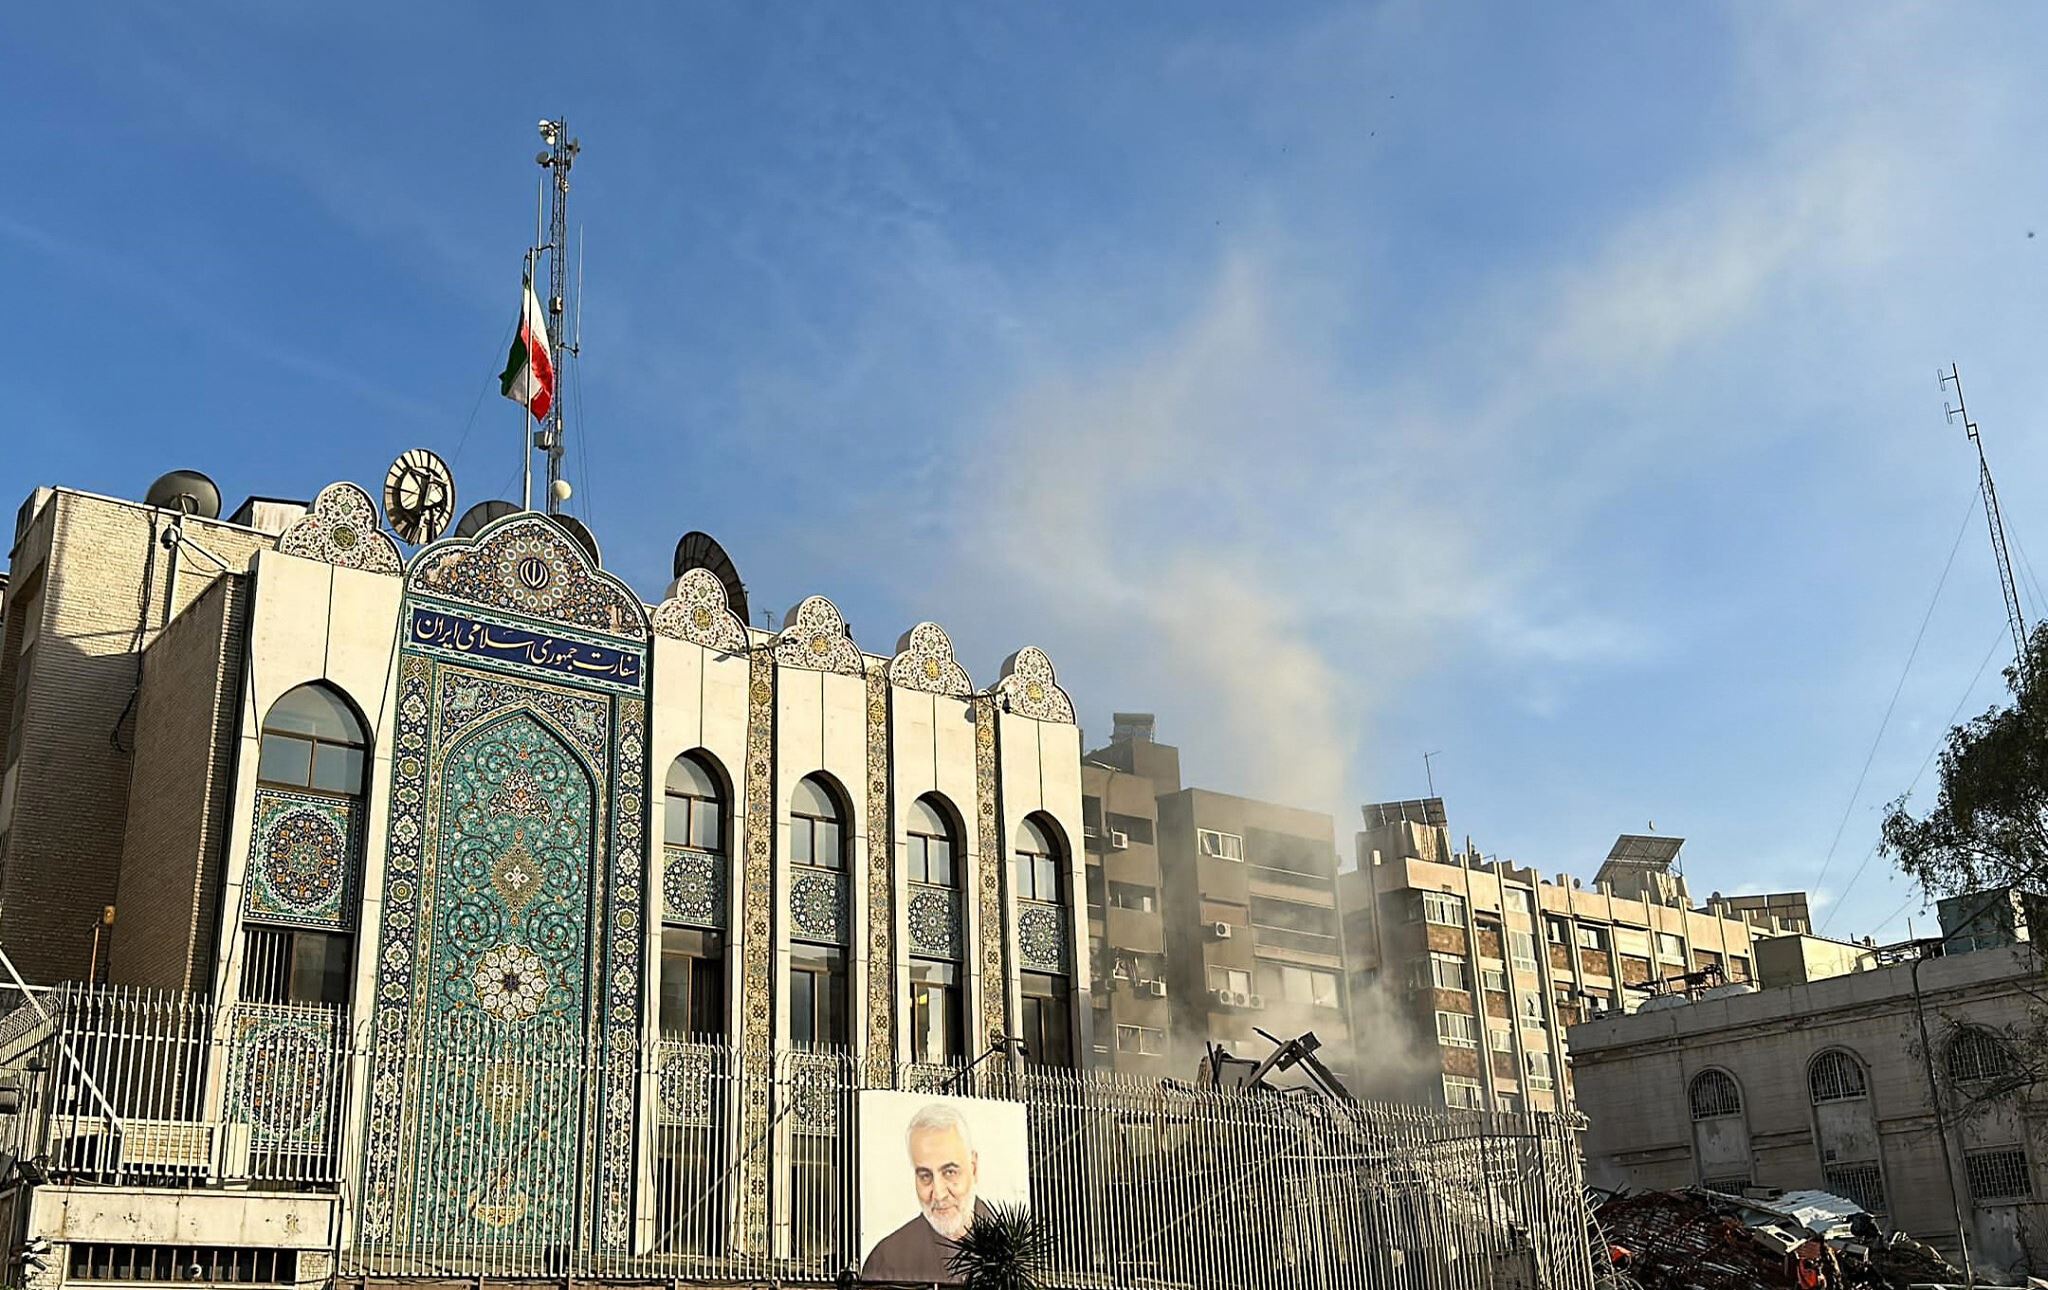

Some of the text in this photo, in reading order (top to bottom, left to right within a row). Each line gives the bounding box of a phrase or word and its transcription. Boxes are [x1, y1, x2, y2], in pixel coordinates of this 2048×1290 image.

[416, 616, 636, 677] سفارت جمهوری اسلامی ایران
